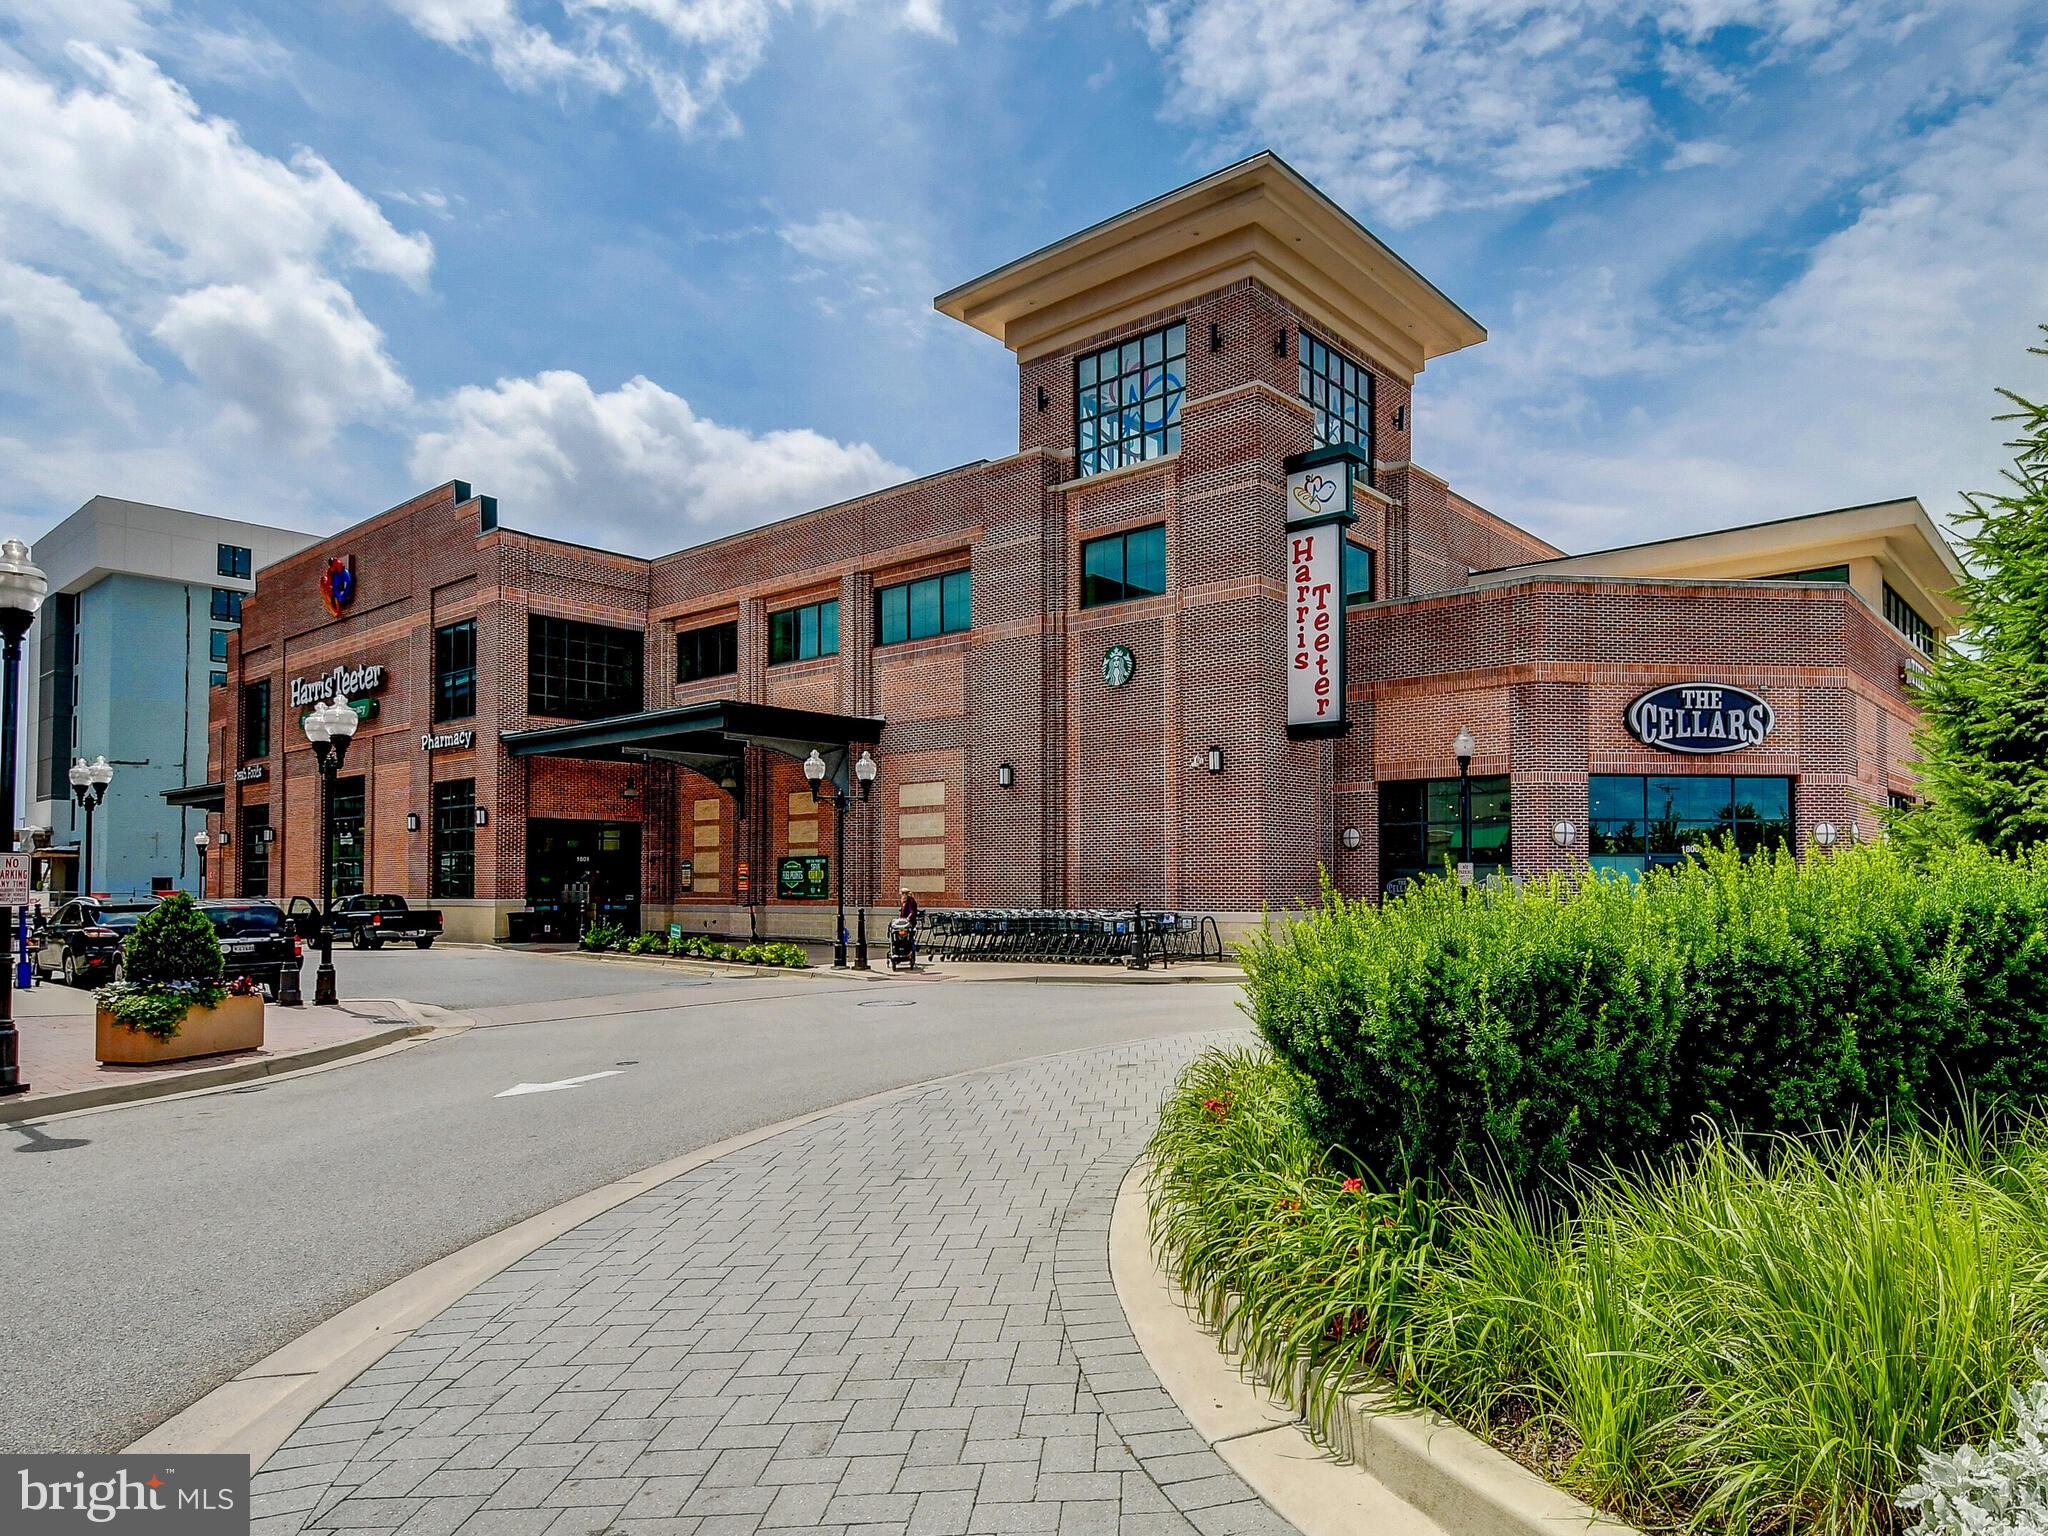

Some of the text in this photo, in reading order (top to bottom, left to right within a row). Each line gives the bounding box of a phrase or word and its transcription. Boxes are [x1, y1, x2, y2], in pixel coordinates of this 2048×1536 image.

[1292, 536, 1314, 670] Harris
[1312, 583, 1331, 716] Teeter
[290, 664, 384, 708] Harris Teeter
[1682, 690, 1722, 709] THE
[1640, 703, 1764, 745] CELLARS
[421, 730, 472, 750] Pharmacy
[5, 858, 19, 868] NO
[0, 869, 28, 880] ARKING
[13, 880, 27, 888] TIME
